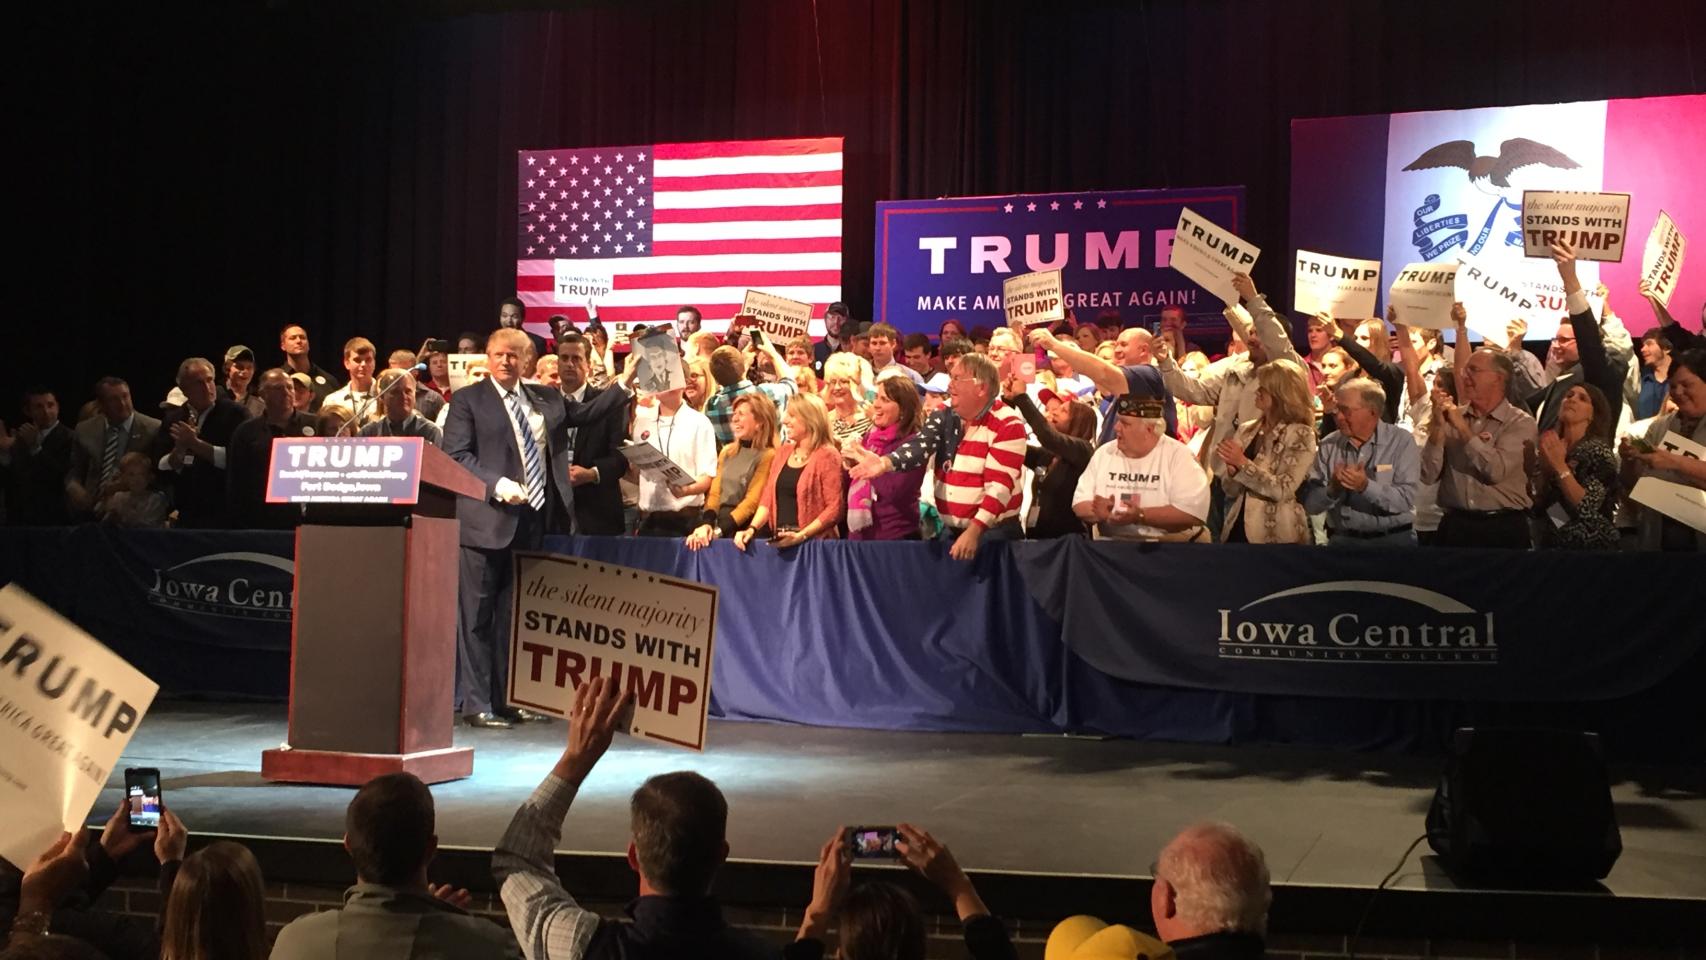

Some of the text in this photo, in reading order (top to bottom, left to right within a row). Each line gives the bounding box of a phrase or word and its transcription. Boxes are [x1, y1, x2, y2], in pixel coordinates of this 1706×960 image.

[1417, 205, 1434, 216] OUR
[1527, 199, 1544, 211] the
[1546, 200, 1573, 211] silent
[1416, 217, 1460, 238] LIBERTIES
[1526, 215, 1622, 228] STANDS WITH
[1180, 217, 1255, 265] TRUMP
[1425, 234, 1461, 258] WE PRIZE
[1478, 227, 1491, 245] OUR
[1526, 229, 1620, 251] TRUMP
[1664, 224, 1674, 248] WITH
[1298, 259, 1377, 281] TRUMP
[1654, 231, 1681, 294] TRUMP
[1400, 270, 1456, 284] TRUMP
[1457, 258, 1532, 309] TRUMP
[560, 284, 609, 297] TRUMP
[917, 295, 967, 310] MAKE
[1063, 292, 1123, 308] GREAT
[1128, 289, 1197, 306] AGAIN!
[1007, 292, 1034, 304] STANDS
[1036, 287, 1058, 298] WITH
[746, 307, 807, 327] STANDS WITH
[1007, 298, 1059, 319] TRUMP
[288, 445, 404, 468] TRUMP
[1108, 472, 1160, 483] TRUMP
[150, 568, 219, 603] Iowa
[526, 576, 705, 638] the silent majority
[1218, 609, 1498, 647] Iowa Central
[524, 610, 701, 668] STANDS WITH
[1219, 647, 1362, 659] COMMUNITY
[522, 641, 698, 716] TRUMP
